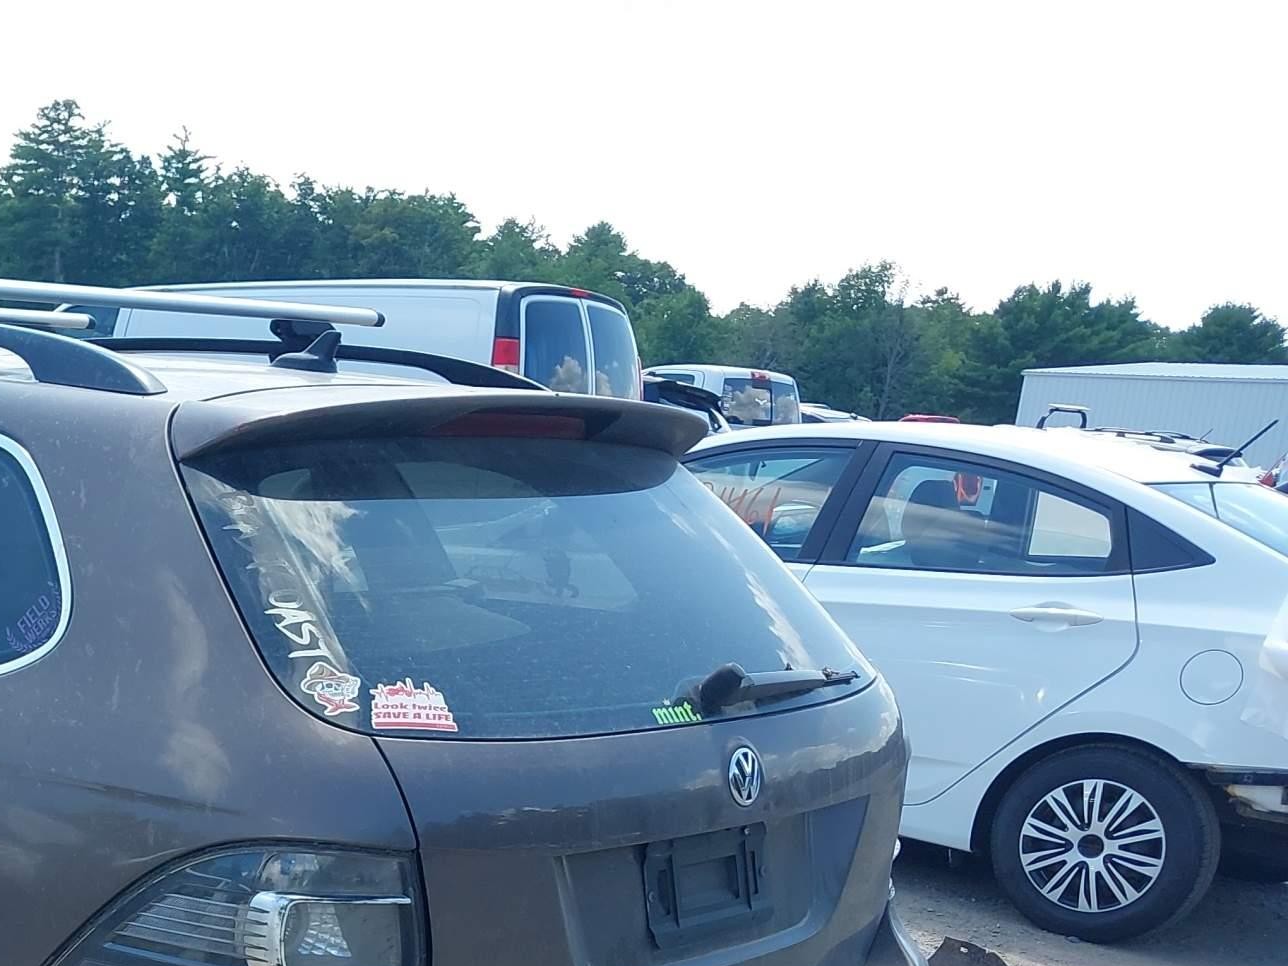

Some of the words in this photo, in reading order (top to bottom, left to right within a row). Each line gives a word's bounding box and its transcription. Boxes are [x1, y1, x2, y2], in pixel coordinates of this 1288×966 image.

[17, 595, 50, 633] FIELD
[373, 702, 409, 710] Look
[412, 703, 447, 712] twice
[373, 711, 409, 719] SAVE
[412, 712, 422, 720] A
[425, 713, 452, 722] LIFE
[729, 747, 761, 807] VW
